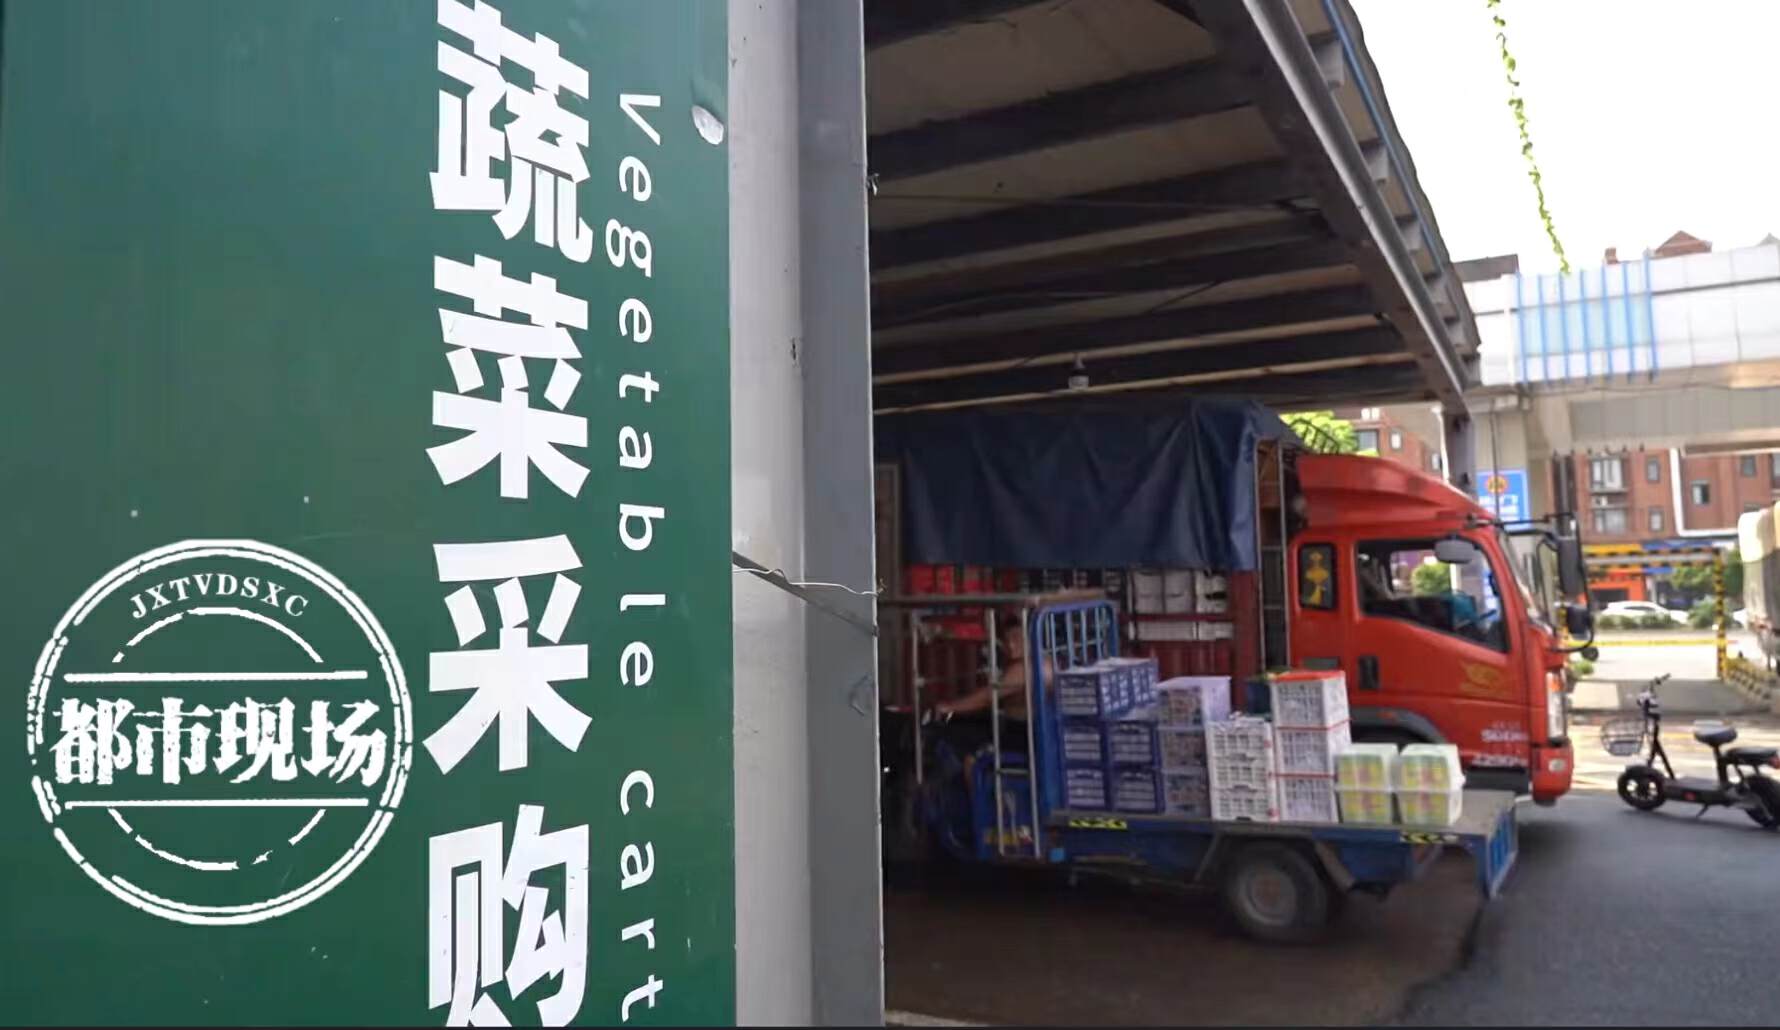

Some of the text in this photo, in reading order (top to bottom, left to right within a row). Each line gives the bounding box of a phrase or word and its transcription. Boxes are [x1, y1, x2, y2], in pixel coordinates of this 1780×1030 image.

[422, 0, 593, 1027] 蔬菜采购
[620, 770, 664, 1022] cart
